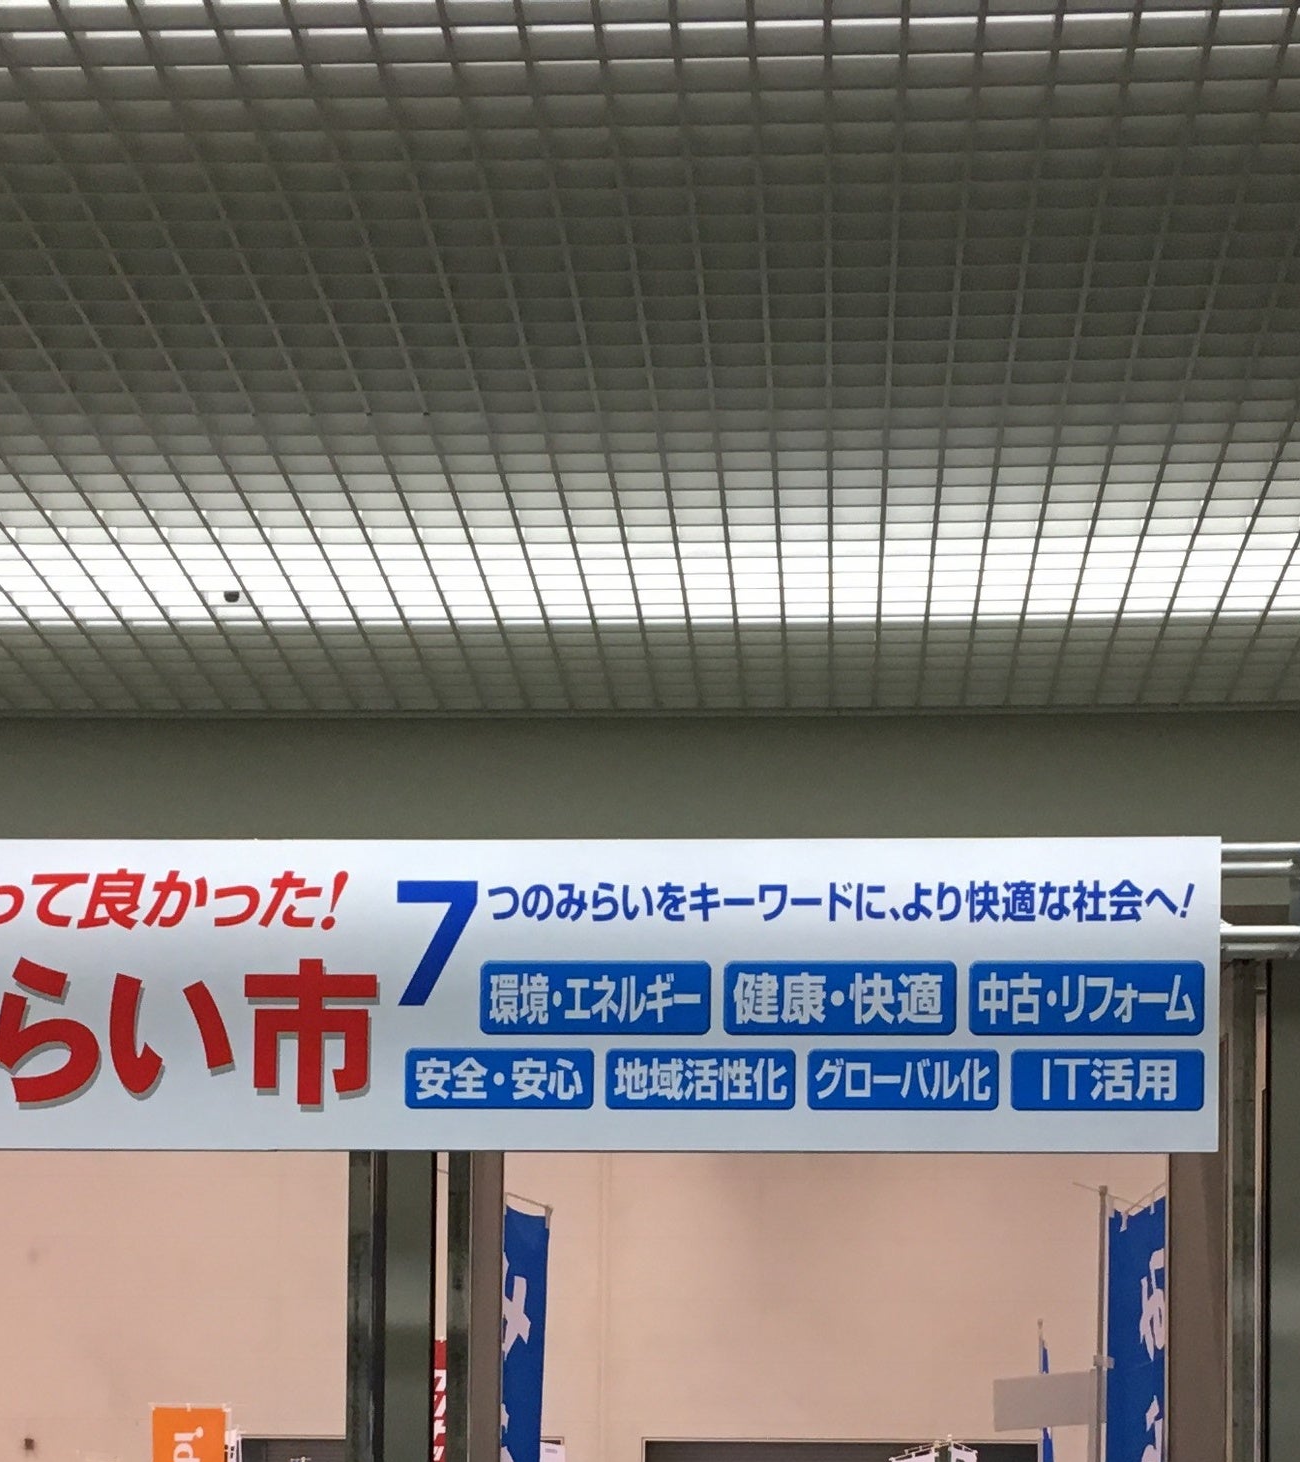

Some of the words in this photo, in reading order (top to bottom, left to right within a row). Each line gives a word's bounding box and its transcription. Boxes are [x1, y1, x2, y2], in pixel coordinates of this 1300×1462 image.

[489, 972, 703, 1027] 環境・エネルギー
[732, 972, 945, 1027] 健康・快適
[977, 972, 1197, 1026] 中古・リフォーム
[414, 1057, 584, 1102] 安全・安心
[614, 1057, 788, 1102] 地域活性化
[815, 1058, 992, 1102] グローバル化
[1040, 1058, 1178, 1102] IT活用
